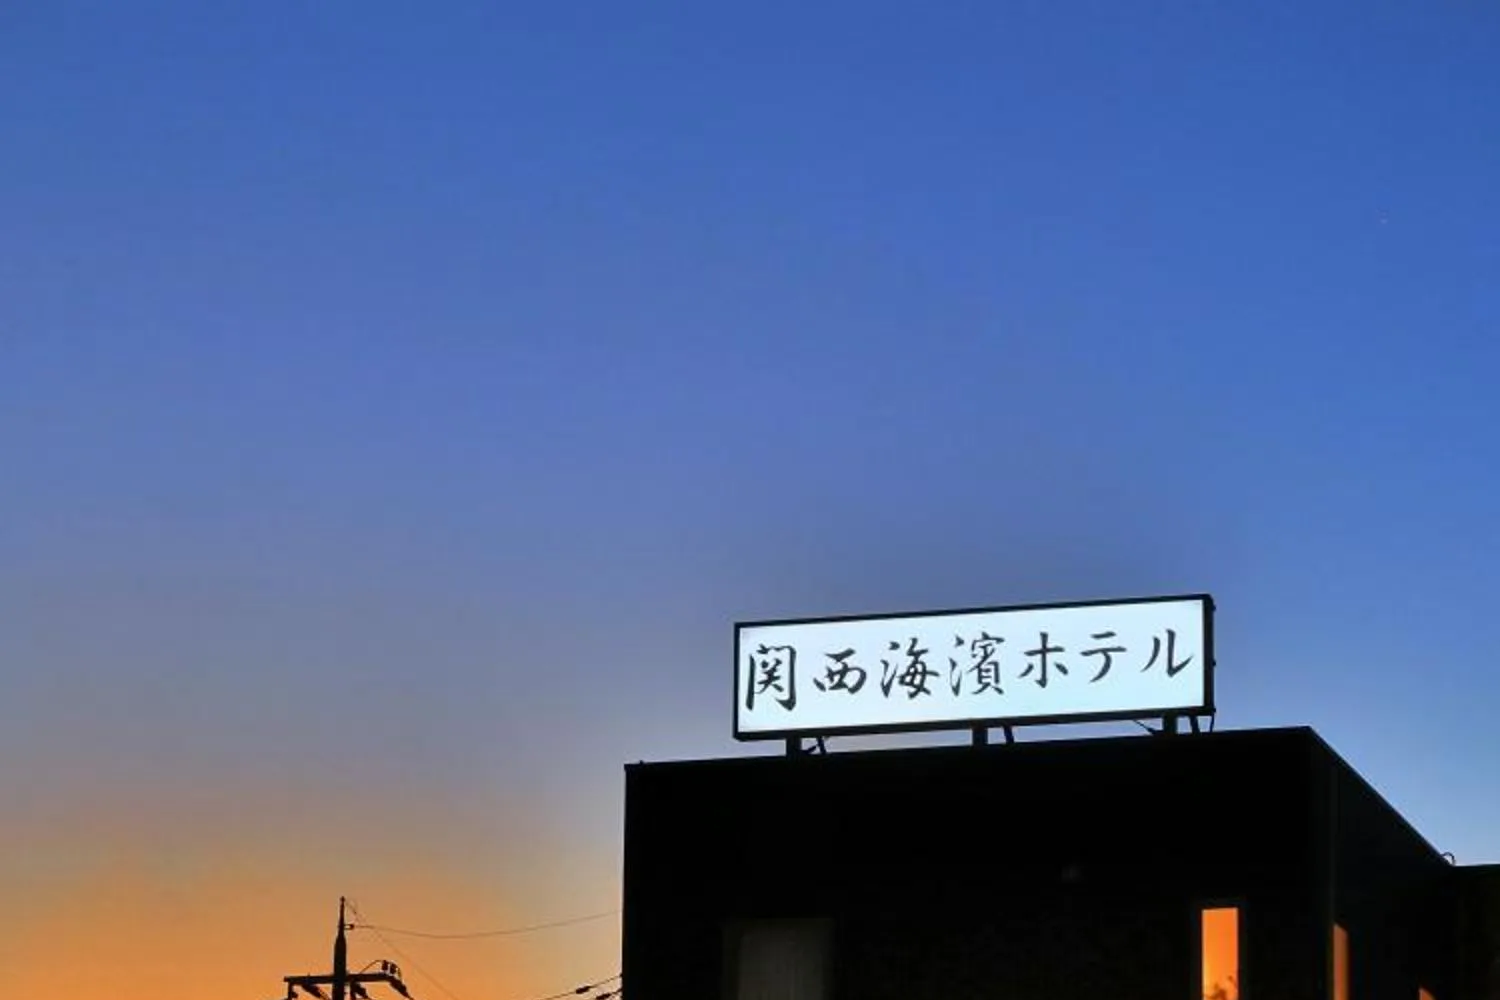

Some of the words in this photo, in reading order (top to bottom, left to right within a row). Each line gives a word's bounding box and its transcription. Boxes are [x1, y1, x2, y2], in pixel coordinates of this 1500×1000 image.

[745, 628, 1194, 712] 関西海濱ホテル
